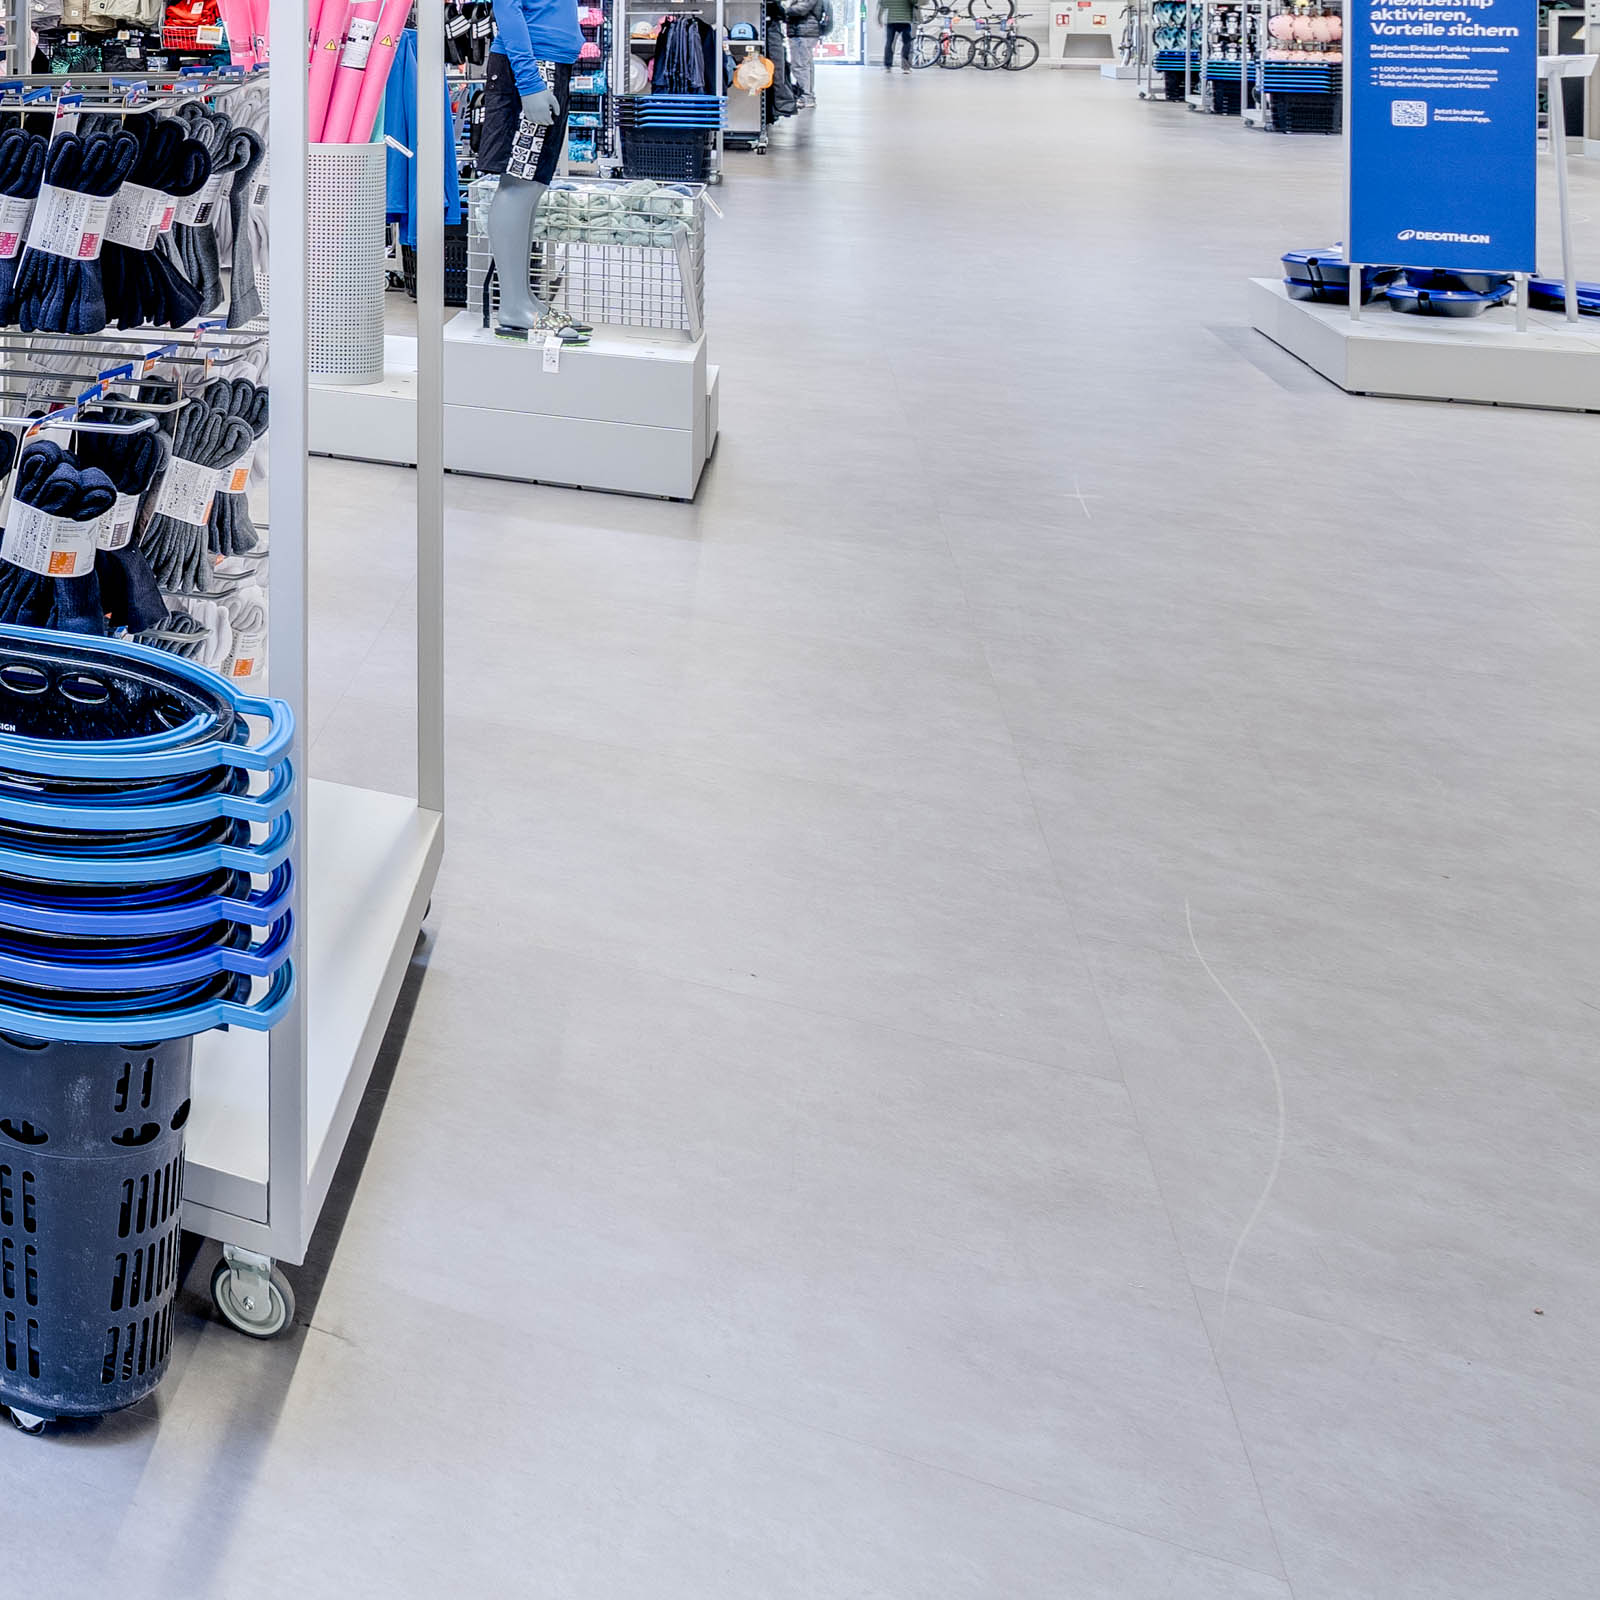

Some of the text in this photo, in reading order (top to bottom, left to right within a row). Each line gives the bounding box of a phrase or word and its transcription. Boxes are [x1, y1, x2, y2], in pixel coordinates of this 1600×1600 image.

[1370, 8, 1472, 24] aktivieren,
[1370, 23, 1519, 37] Vorteile sichern
[1415, 231, 1490, 244] DECATHLON
